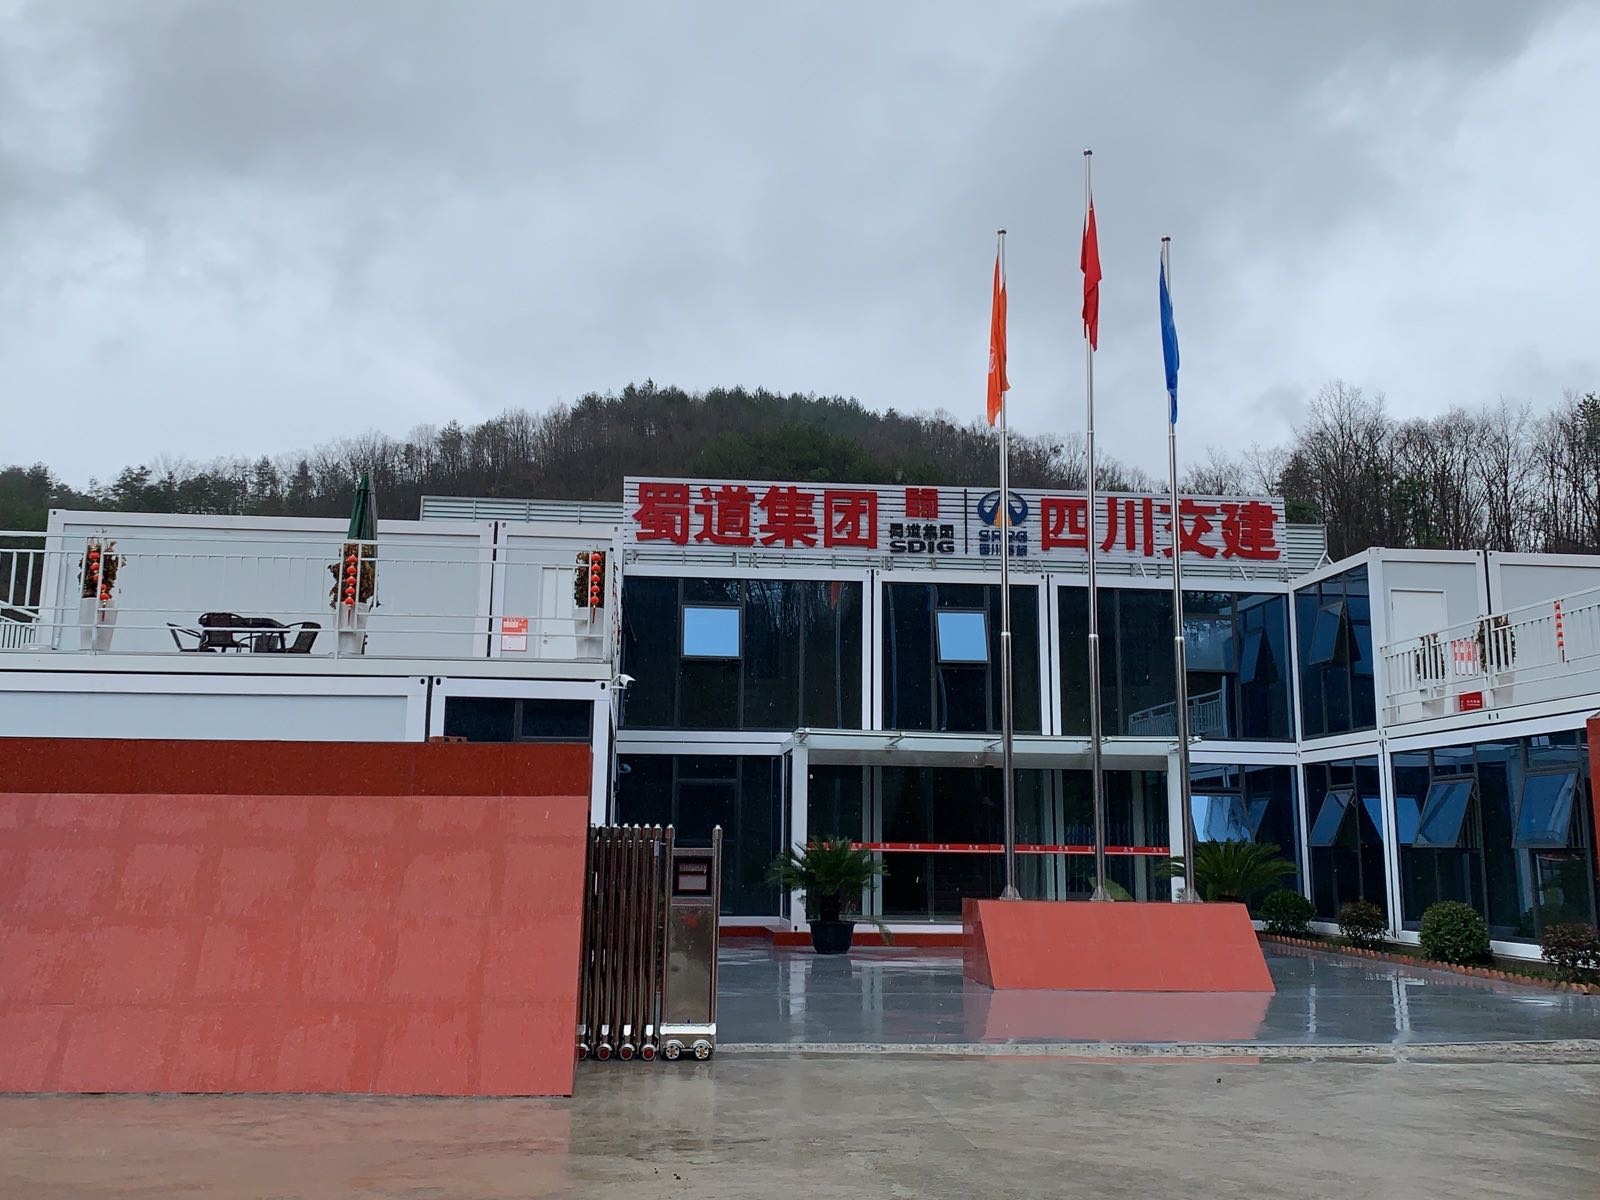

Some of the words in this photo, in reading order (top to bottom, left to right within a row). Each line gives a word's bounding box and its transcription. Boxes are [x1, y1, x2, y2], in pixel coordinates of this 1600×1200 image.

[633, 483, 877, 549] 蜀道集团
[889, 540, 954, 553] SDIG
[1041, 497, 1281, 561] 四川交建
